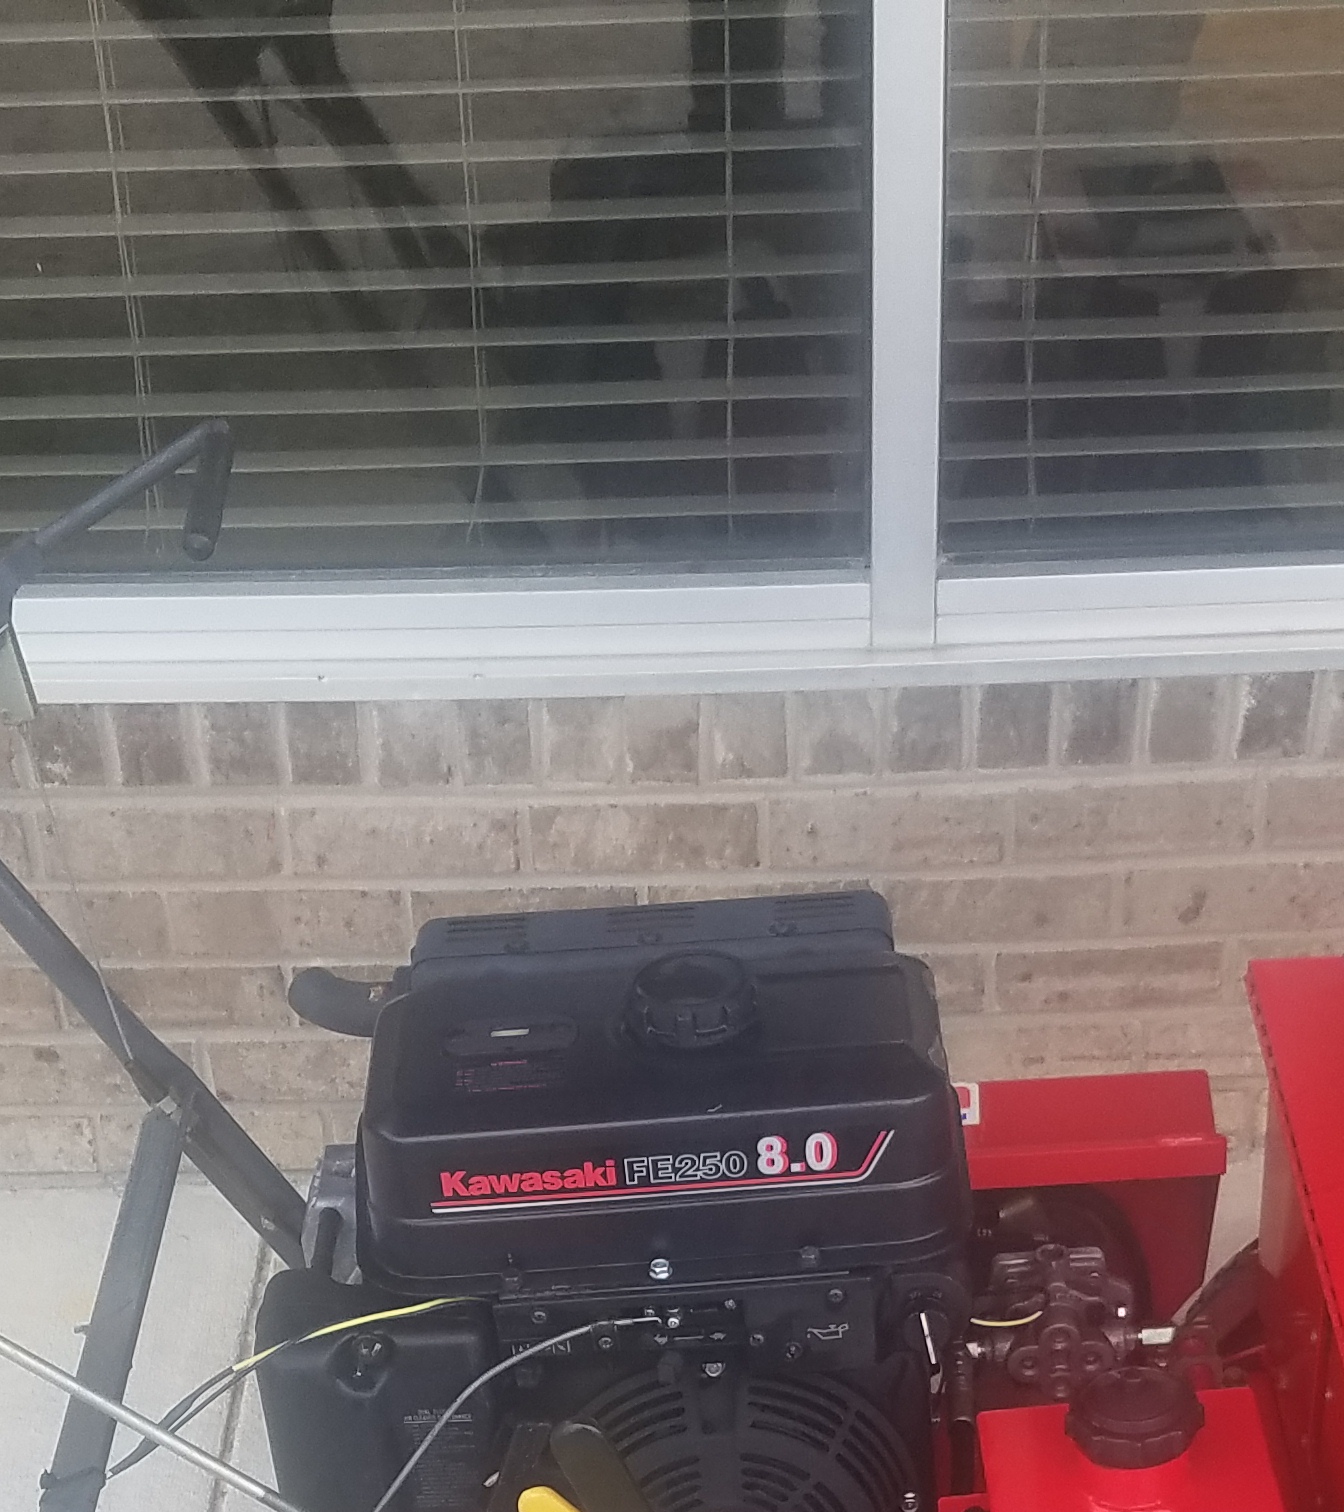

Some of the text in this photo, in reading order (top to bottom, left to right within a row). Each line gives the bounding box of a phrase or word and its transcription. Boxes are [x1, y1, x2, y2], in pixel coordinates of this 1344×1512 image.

[440, 1132, 838, 1198] Kawasaki FE250 8.0
